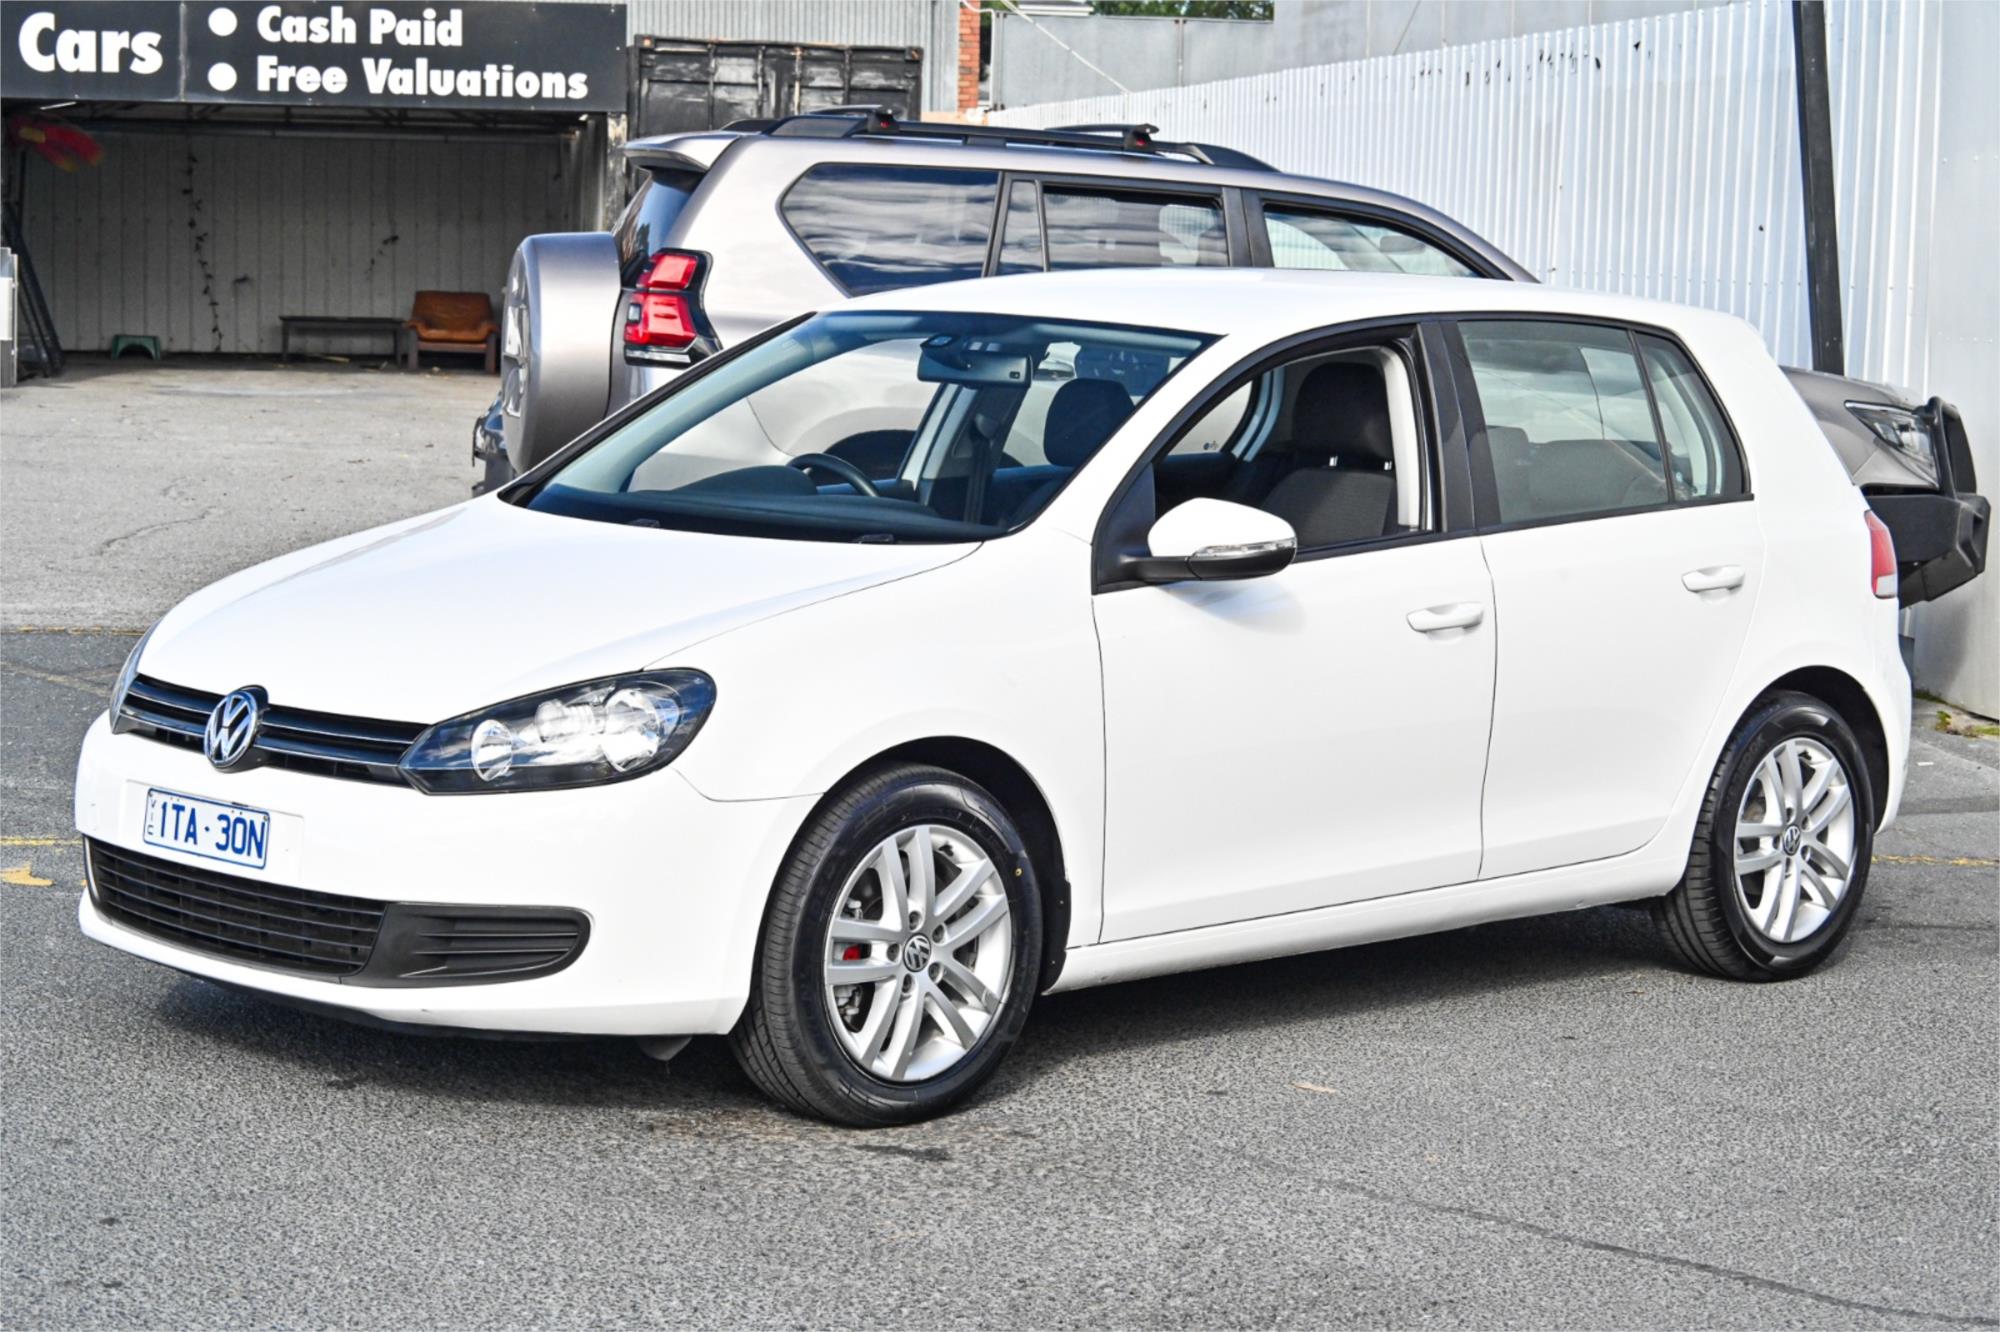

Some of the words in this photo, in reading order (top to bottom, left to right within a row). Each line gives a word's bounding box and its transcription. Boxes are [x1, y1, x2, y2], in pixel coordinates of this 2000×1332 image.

[18, 11, 164, 75] Cars
[256, 5, 357, 44] Cash
[369, 8, 463, 47] Paid
[256, 54, 348, 94] Free
[361, 57, 589, 100] Valuations
